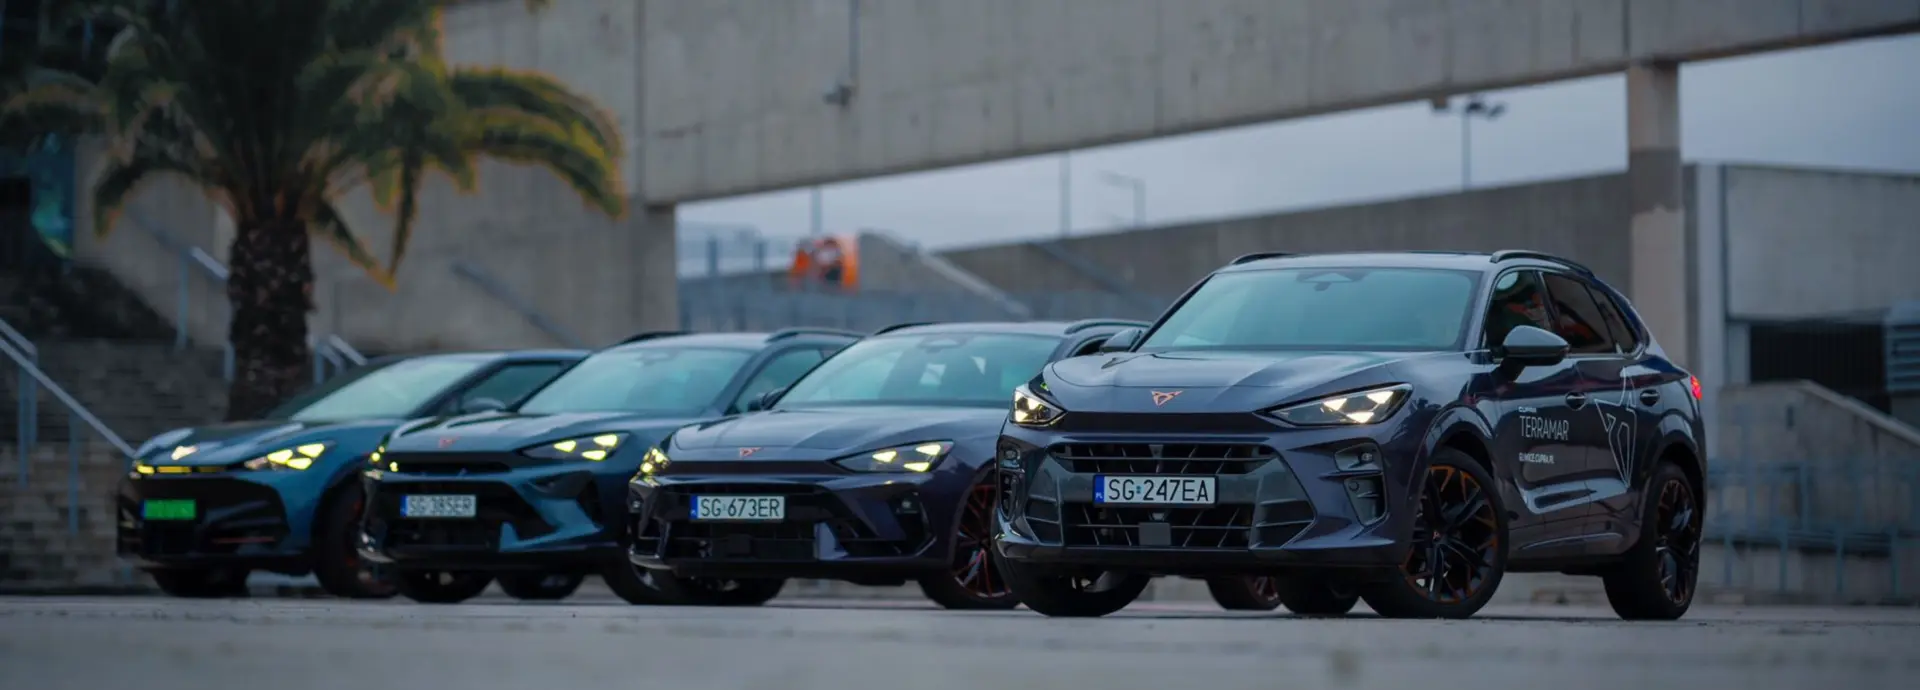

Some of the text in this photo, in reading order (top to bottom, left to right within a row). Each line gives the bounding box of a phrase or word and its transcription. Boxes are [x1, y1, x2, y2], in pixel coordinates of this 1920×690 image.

[1520, 415, 1570, 441] TERRAMAR
[1108, 478, 1209, 502] SG 247EA
[701, 498, 722, 517] SG
[727, 498, 780, 517] 673ER
